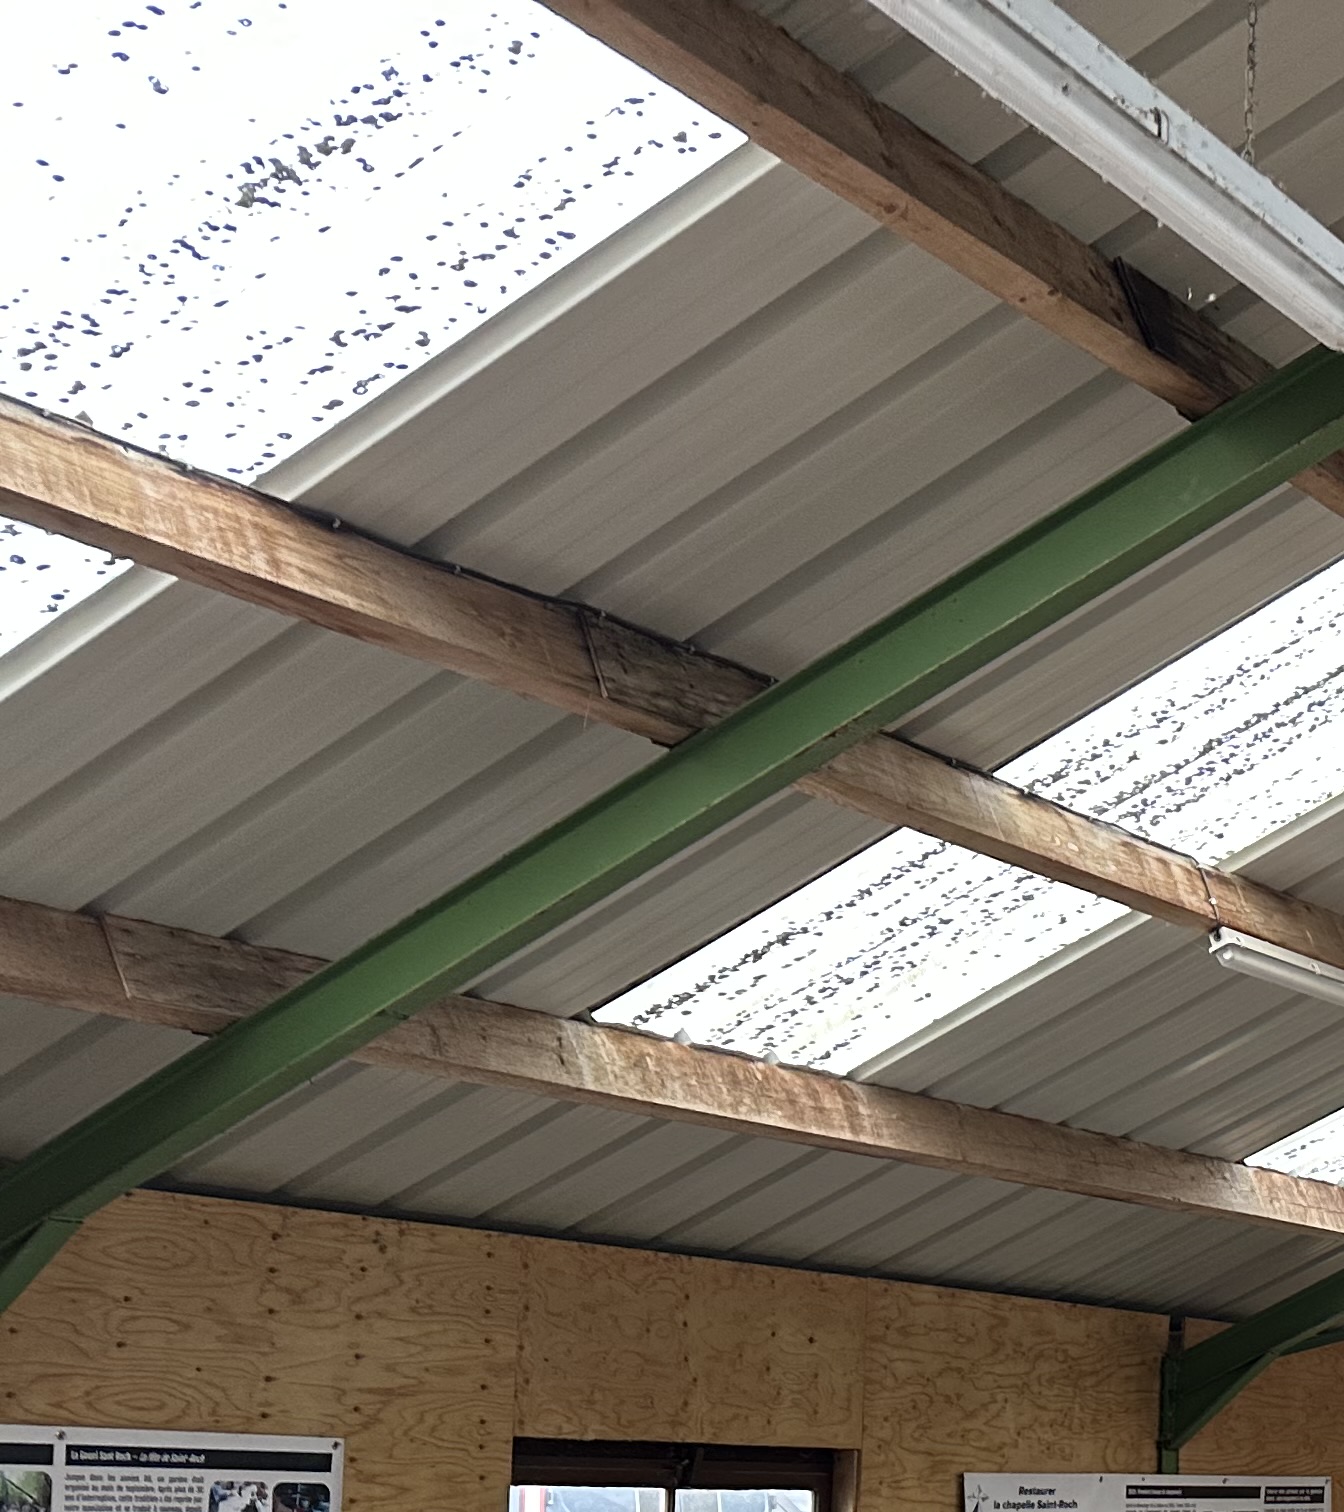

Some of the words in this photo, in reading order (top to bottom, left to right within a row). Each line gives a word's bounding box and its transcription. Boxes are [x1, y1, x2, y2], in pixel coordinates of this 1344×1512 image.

[1019, 1486, 1056, 1495] Restaurer
[994, 1500, 1000, 1508] la
[1002, 1500, 1035, 1510] chapelle
[1037, 1500, 1078, 1508] Saint-Roch
